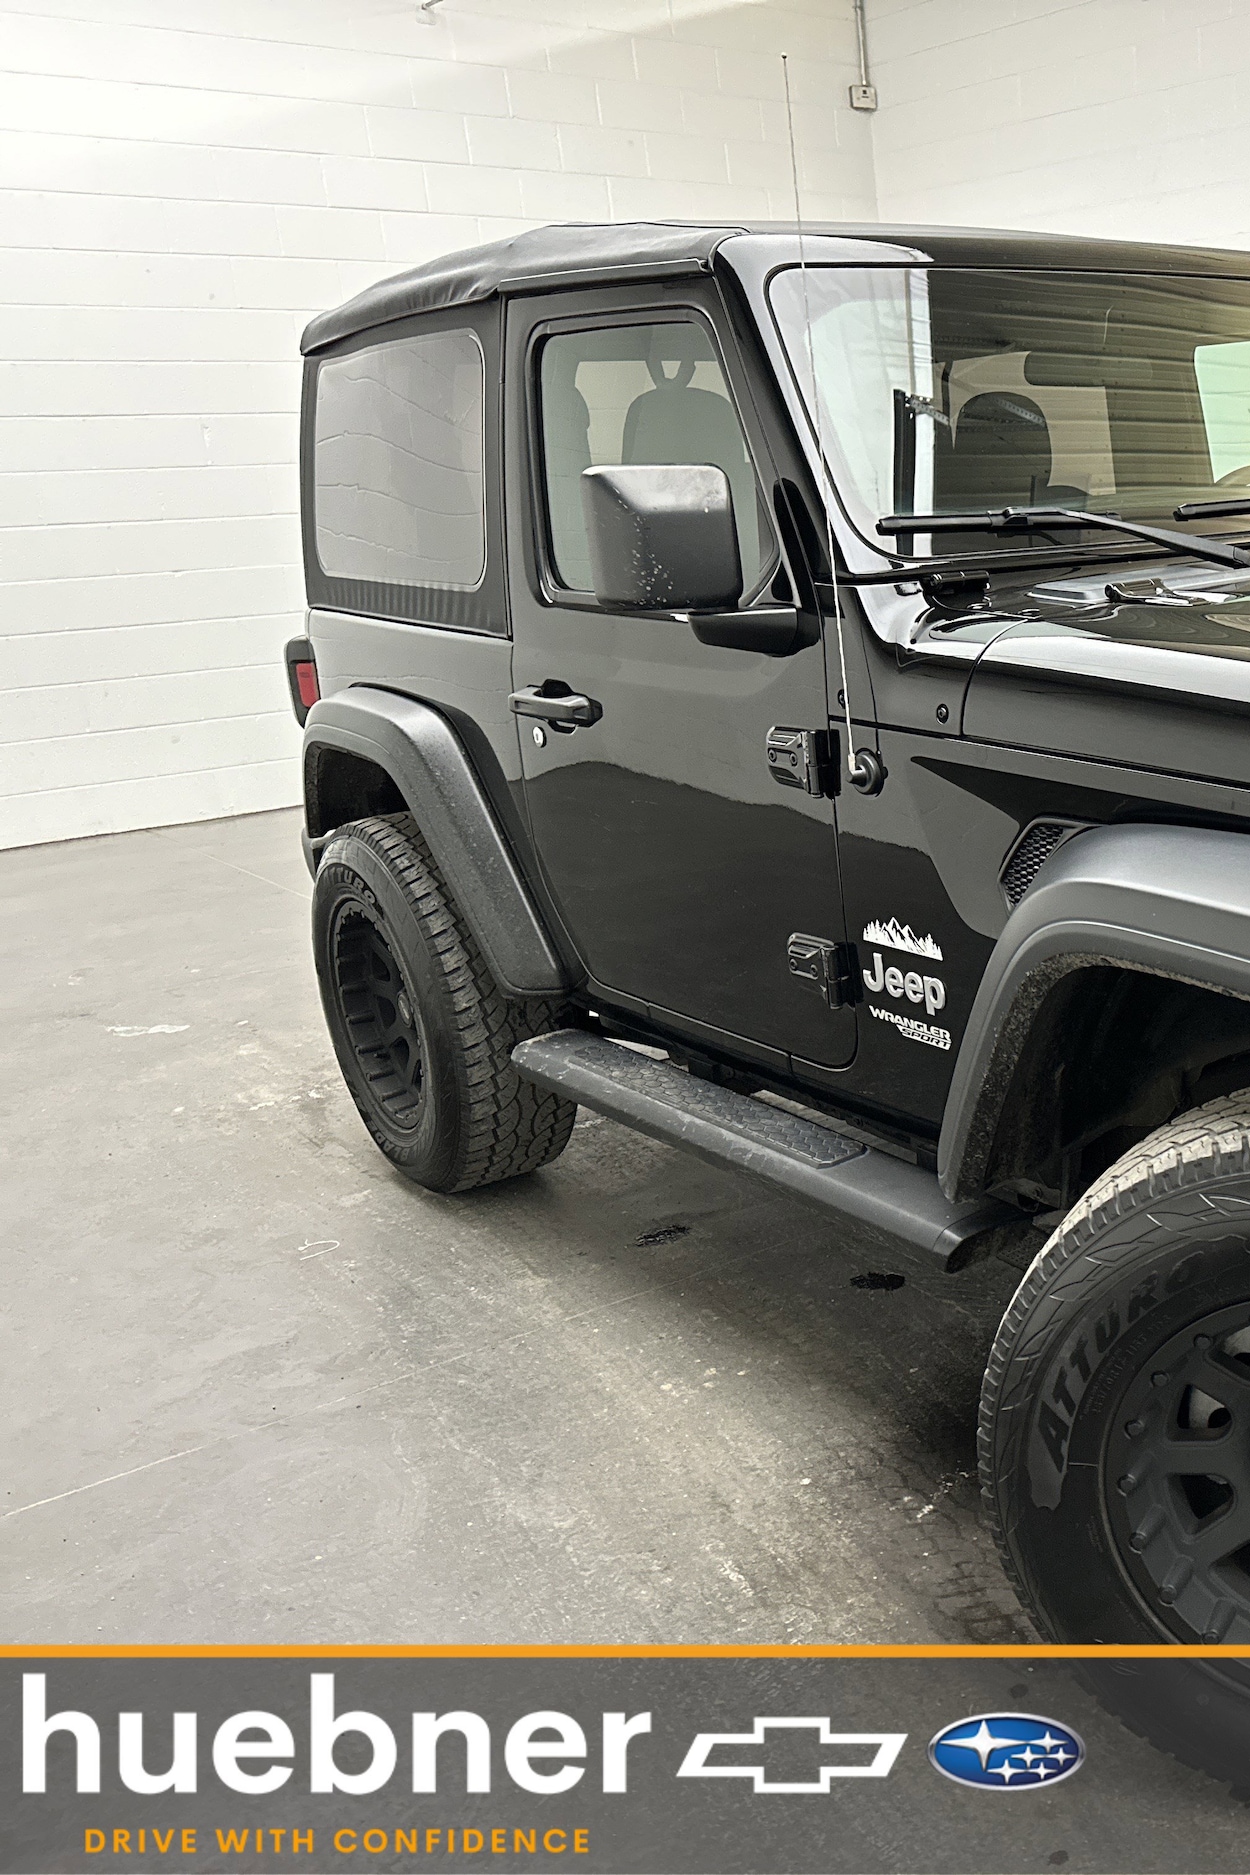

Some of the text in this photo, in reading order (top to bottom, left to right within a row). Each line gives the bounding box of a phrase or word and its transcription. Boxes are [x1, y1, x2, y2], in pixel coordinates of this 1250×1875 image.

[862, 952, 946, 1017] Jeep
[868, 1004, 951, 1041] WRANGLER
[901, 1028, 949, 1048] SPORT
[1037, 1250, 1206, 1475] ATTURO
